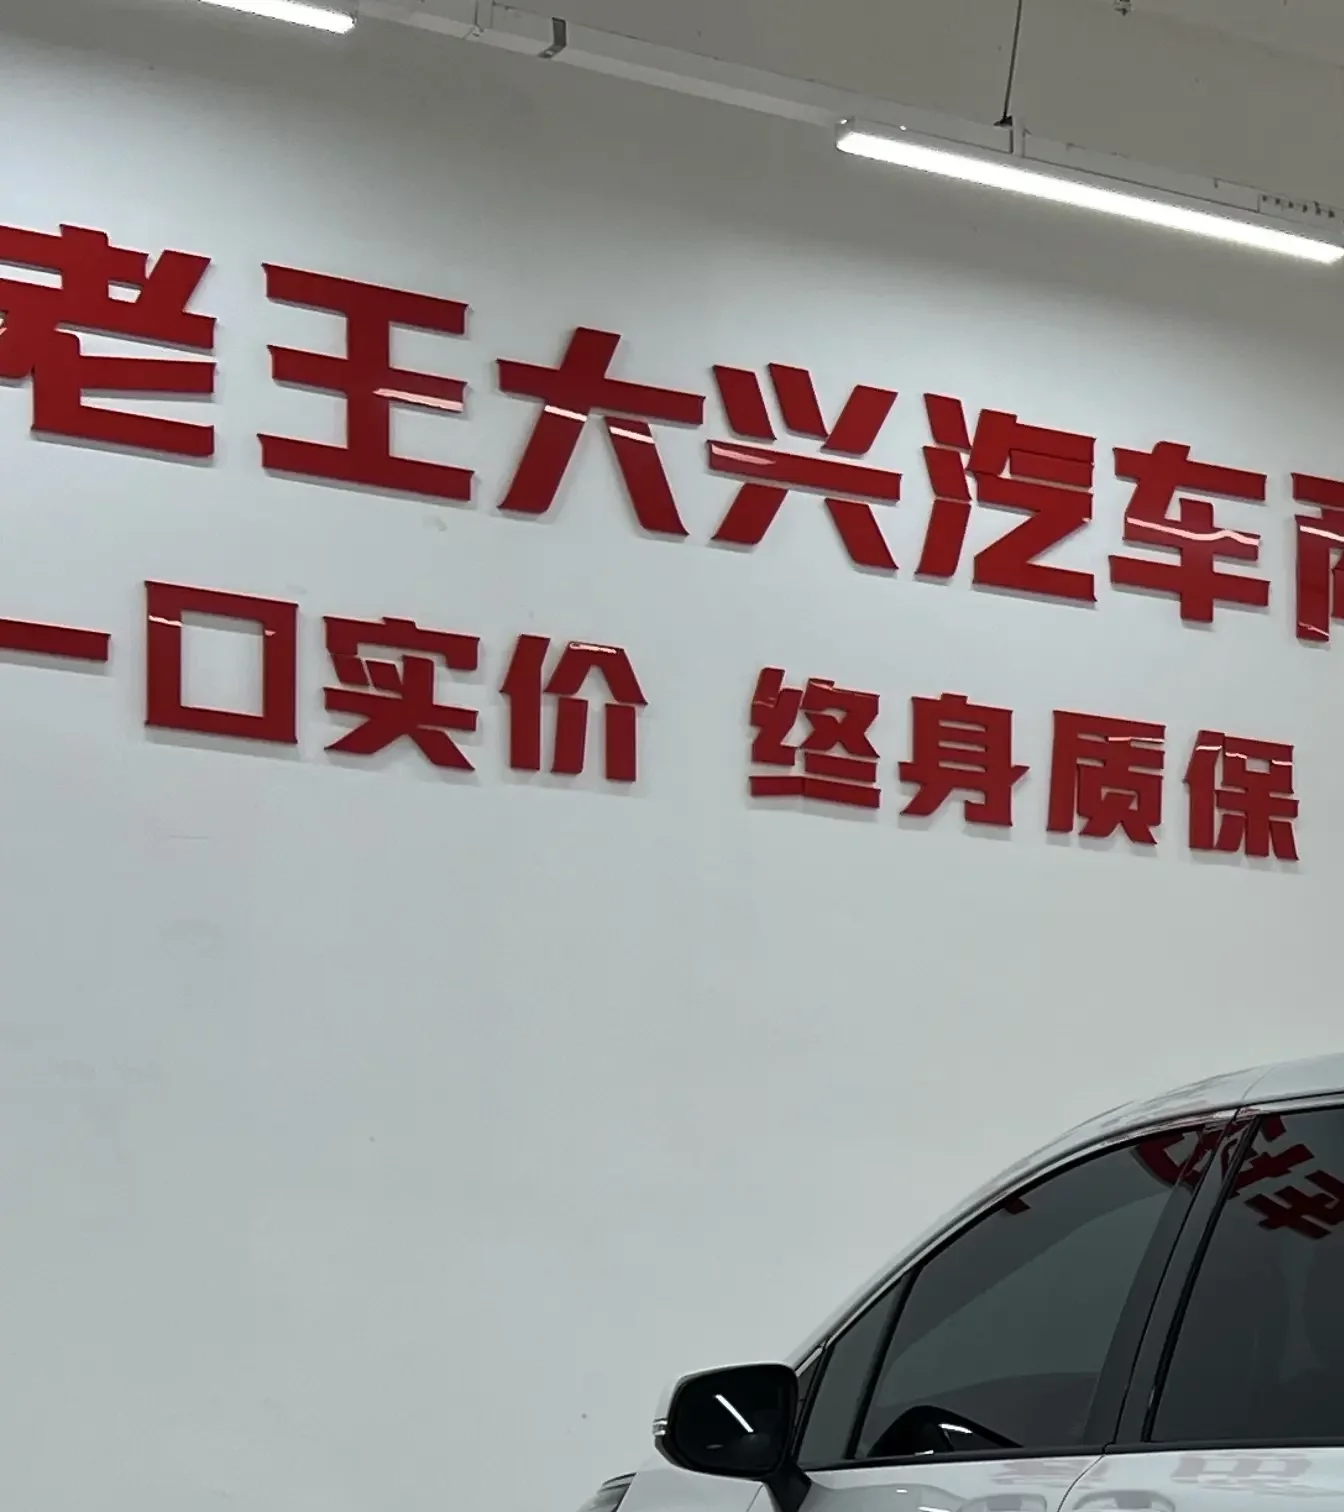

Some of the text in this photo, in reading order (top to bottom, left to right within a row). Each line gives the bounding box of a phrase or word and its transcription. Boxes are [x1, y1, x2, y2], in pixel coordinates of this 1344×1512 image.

[0, 581, 1300, 861] 一口实价 终身质保
